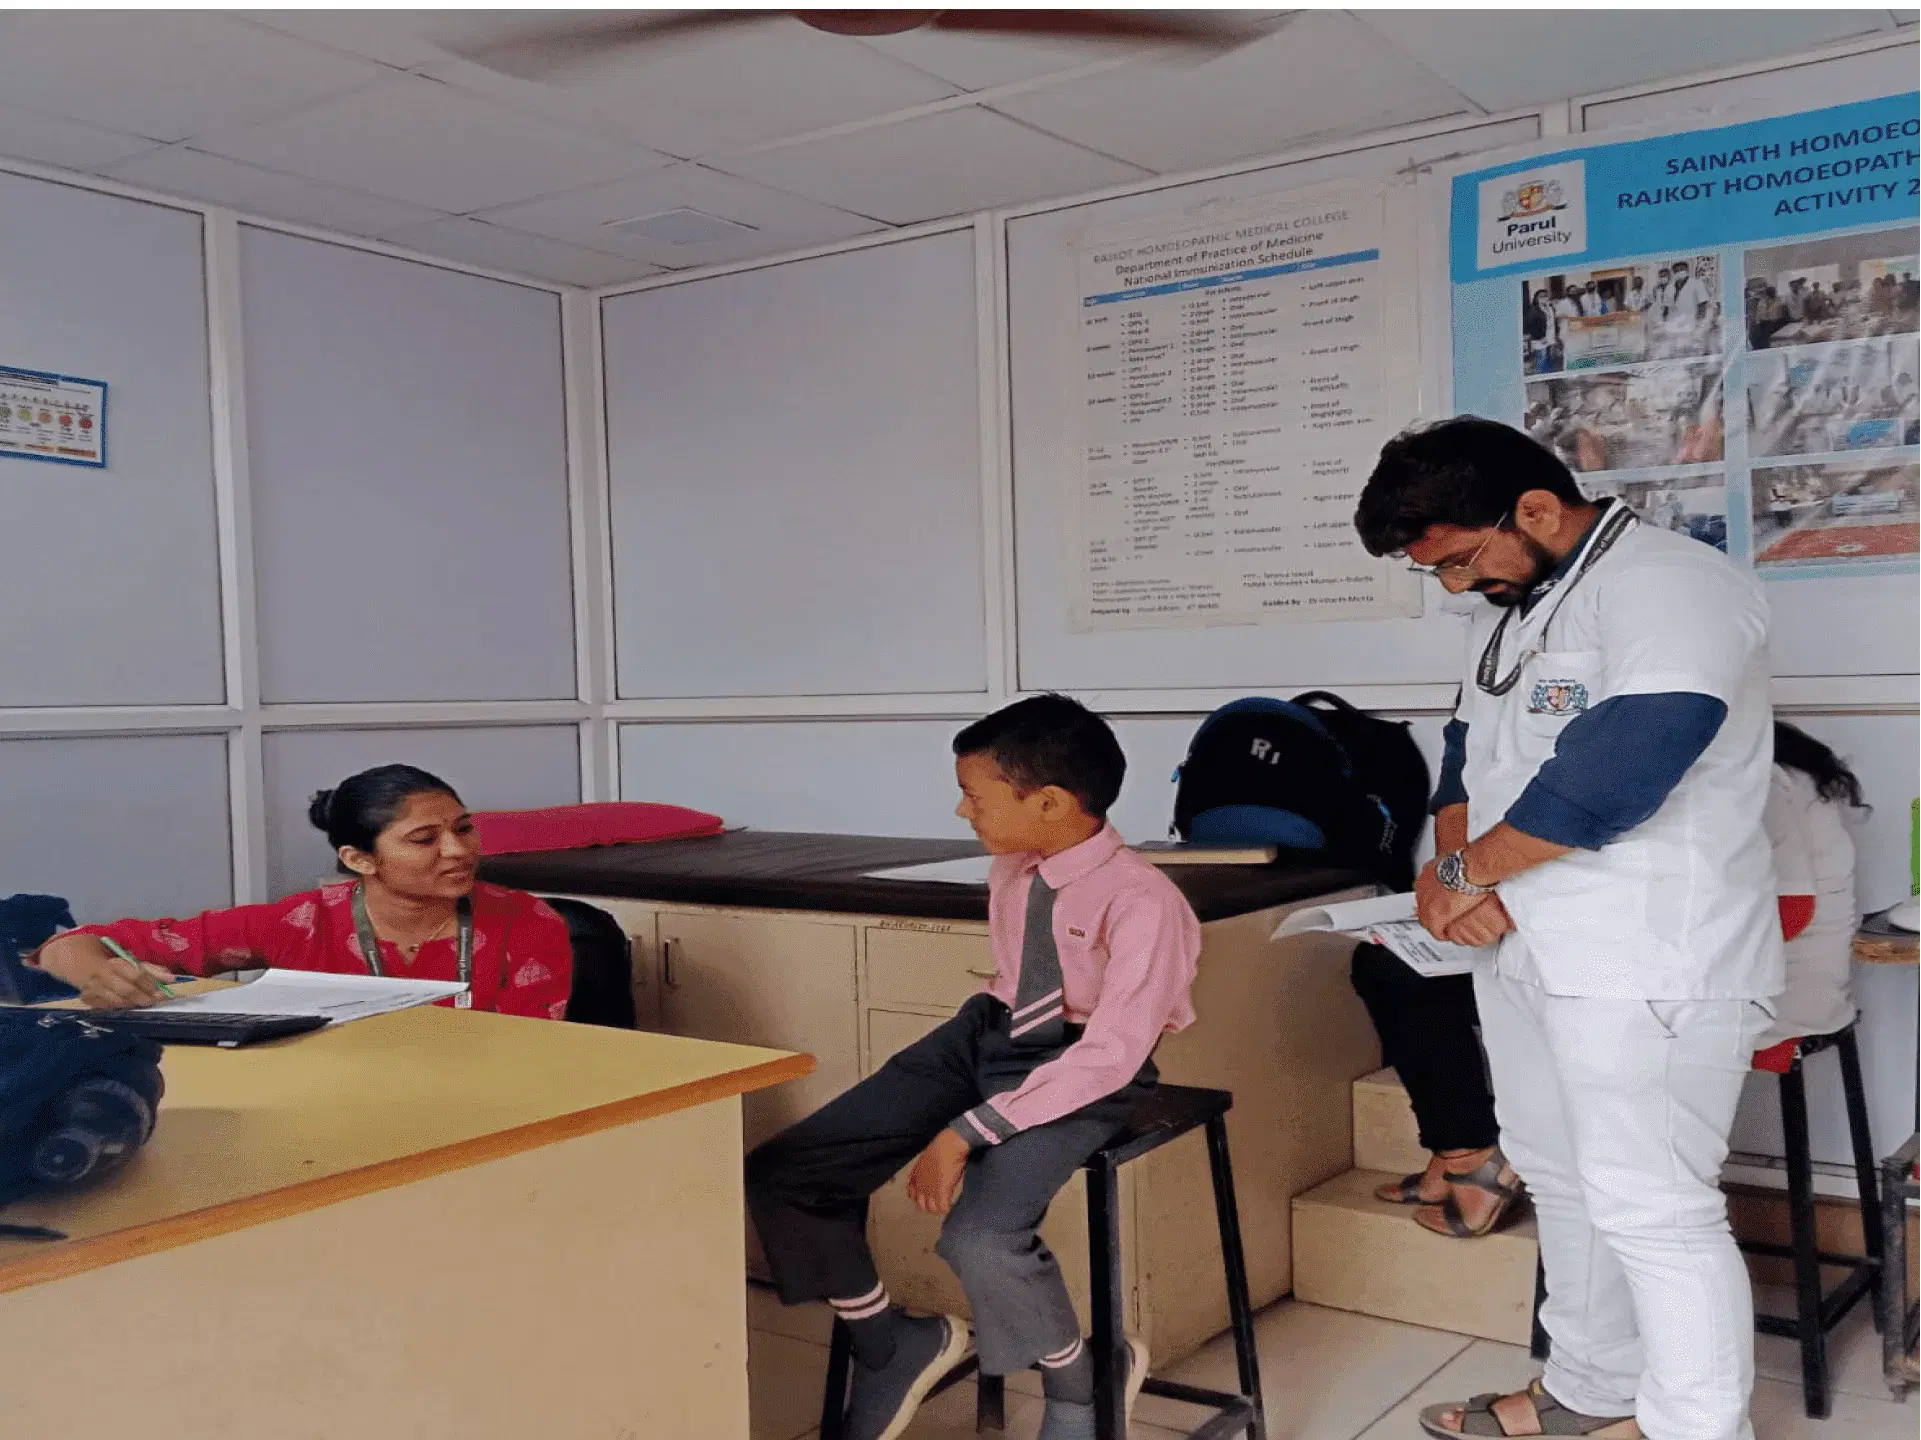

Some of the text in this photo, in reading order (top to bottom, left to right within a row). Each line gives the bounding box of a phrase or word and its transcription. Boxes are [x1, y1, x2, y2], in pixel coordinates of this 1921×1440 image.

[1665, 118, 1920, 176] SAINATH HOMOEO
[1616, 181, 1717, 210] RAJKOT
[1773, 181, 1898, 216] ACTIVITY
[1093, 250, 1134, 264] RAJKOT
[1235, 222, 1289, 239] MEDICAL
[1293, 210, 1351, 229] COLLEGE
[1492, 230, 1572, 254] University
[1507, 216, 1556, 236] Parul
[1115, 232, 1324, 276] Department of Practice of Medicine
[1124, 268, 1172, 287] National
[1174, 257, 1255, 277] Immunization
[1258, 246, 1314, 264] Schedule
